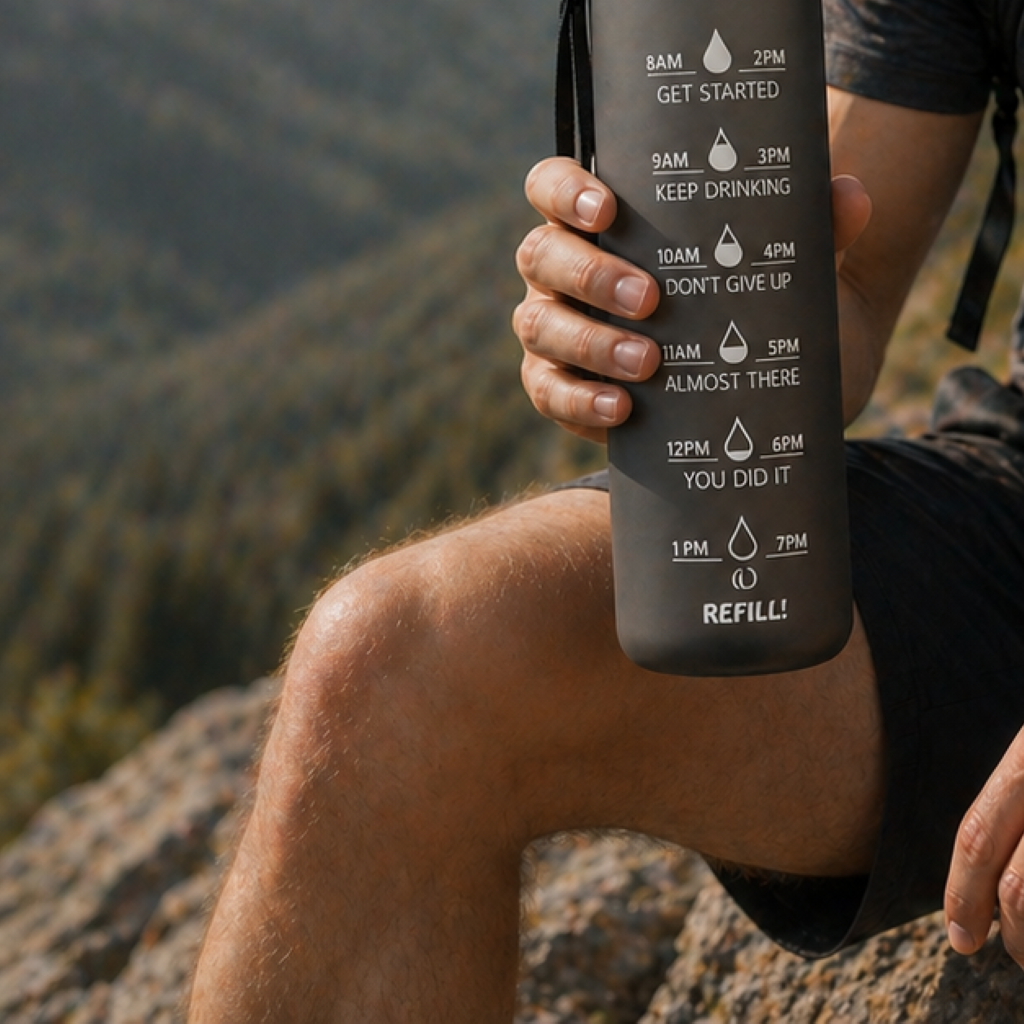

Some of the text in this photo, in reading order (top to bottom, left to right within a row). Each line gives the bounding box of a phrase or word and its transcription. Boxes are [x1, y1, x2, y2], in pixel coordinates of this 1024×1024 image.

[646, 49, 786, 71] 8AM 2PM
[657, 80, 780, 104] GET STARTED
[652, 146, 791, 169] 9AM 3PM
[655, 177, 791, 202] KEEP DRINKING
[657, 242, 796, 265] 10AM 4PM
[665, 271, 792, 296] DON'T GIVE UP
[662, 337, 800, 360] 11AM 5PM
[664, 366, 801, 393] ALMOST THERE
[667, 433, 804, 457] 12PM 6PM
[683, 464, 792, 490] YOU DID IT
[775, 532, 808, 552] 7PM
[702, 598, 788, 625] REFILL!
